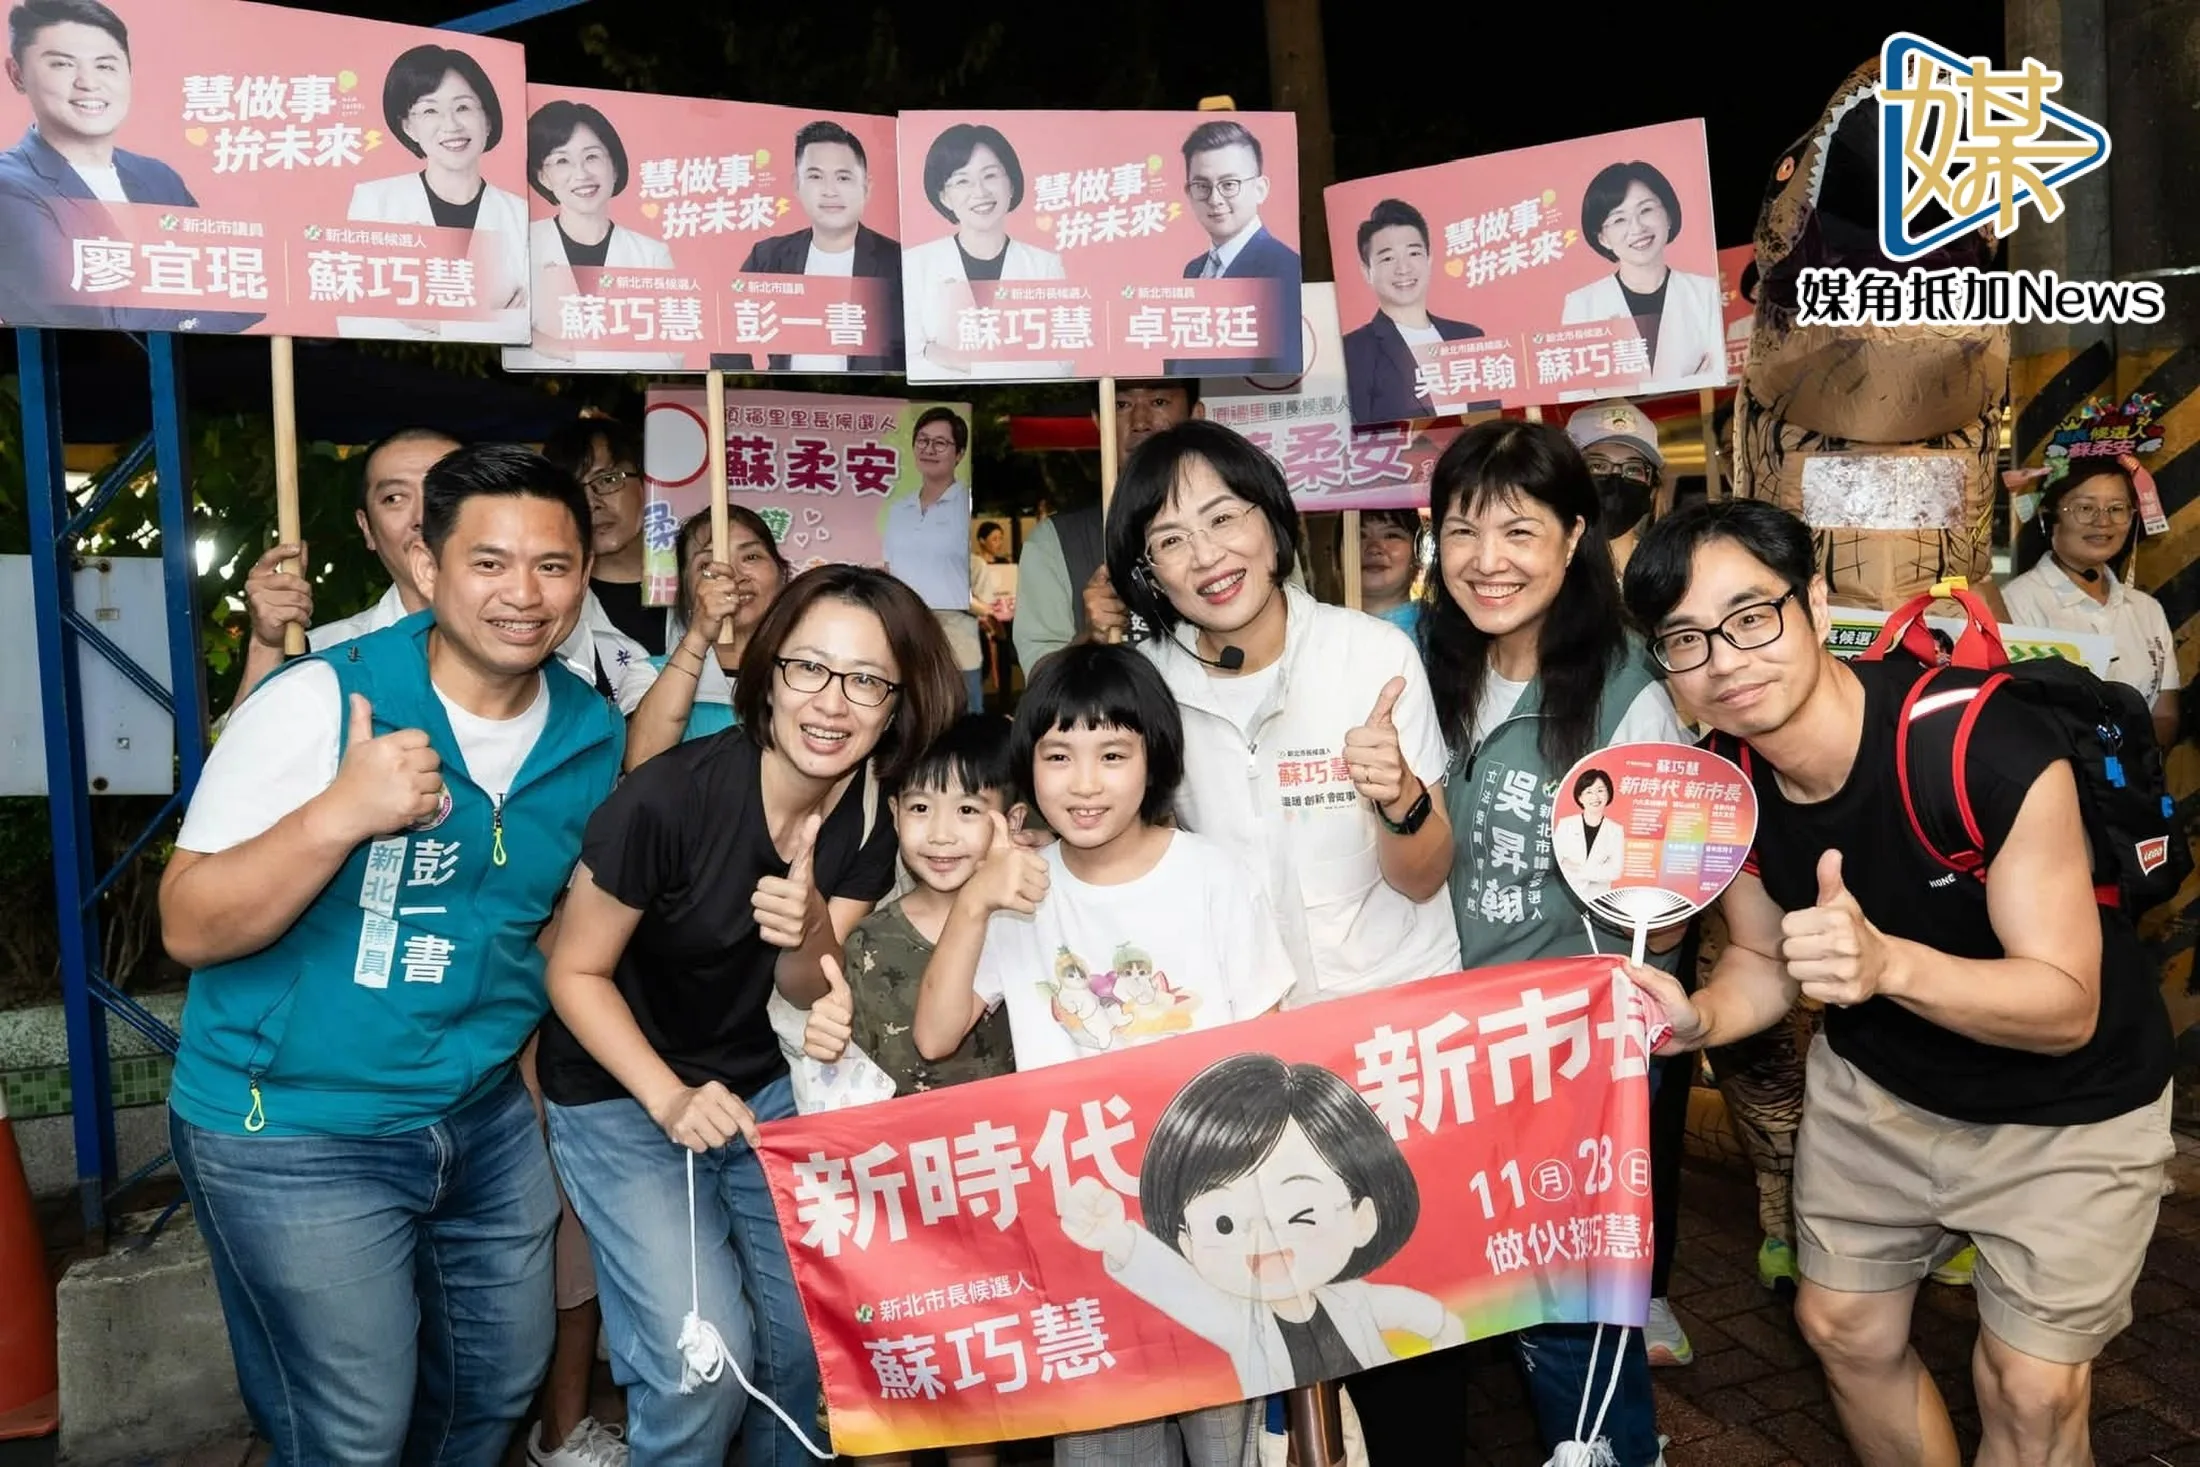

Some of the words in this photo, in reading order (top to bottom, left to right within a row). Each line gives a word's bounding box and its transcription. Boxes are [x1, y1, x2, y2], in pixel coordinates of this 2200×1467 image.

[182, 74, 337, 123] 慧做事
[639, 154, 755, 198] 慧做事
[1034, 163, 1147, 212] 慧做事
[182, 218, 264, 237] 新北市議員
[325, 228, 428, 248] 新北市長候選人
[1444, 197, 1542, 257] 慧做事
[70, 236, 268, 300] 廖宜琨
[307, 249, 477, 307] 蘇巧慧
[558, 293, 704, 342] 蘇巧慧
[734, 299, 867, 346] 彭一書
[955, 305, 1094, 350] 蘇巧慧
[1125, 305, 1260, 350] 卓冠廷
[1414, 354, 1516, 398] 吳昇翰
[1536, 337, 1651, 386] 蘇巧慧
[727, 435, 896, 494] 蘇柔安
[1619, 776, 1682, 799] 新時代
[1684, 780, 1743, 803] 新市長
[1656, 759, 1700, 776] 蘇巧慧
[400, 838, 462, 984] 彭一書
[792, 1094, 1140, 1257] 新時代
[879, 1271, 1034, 1323] 新北市長候選人
[863, 1298, 1117, 1400] 蘇巧慧
